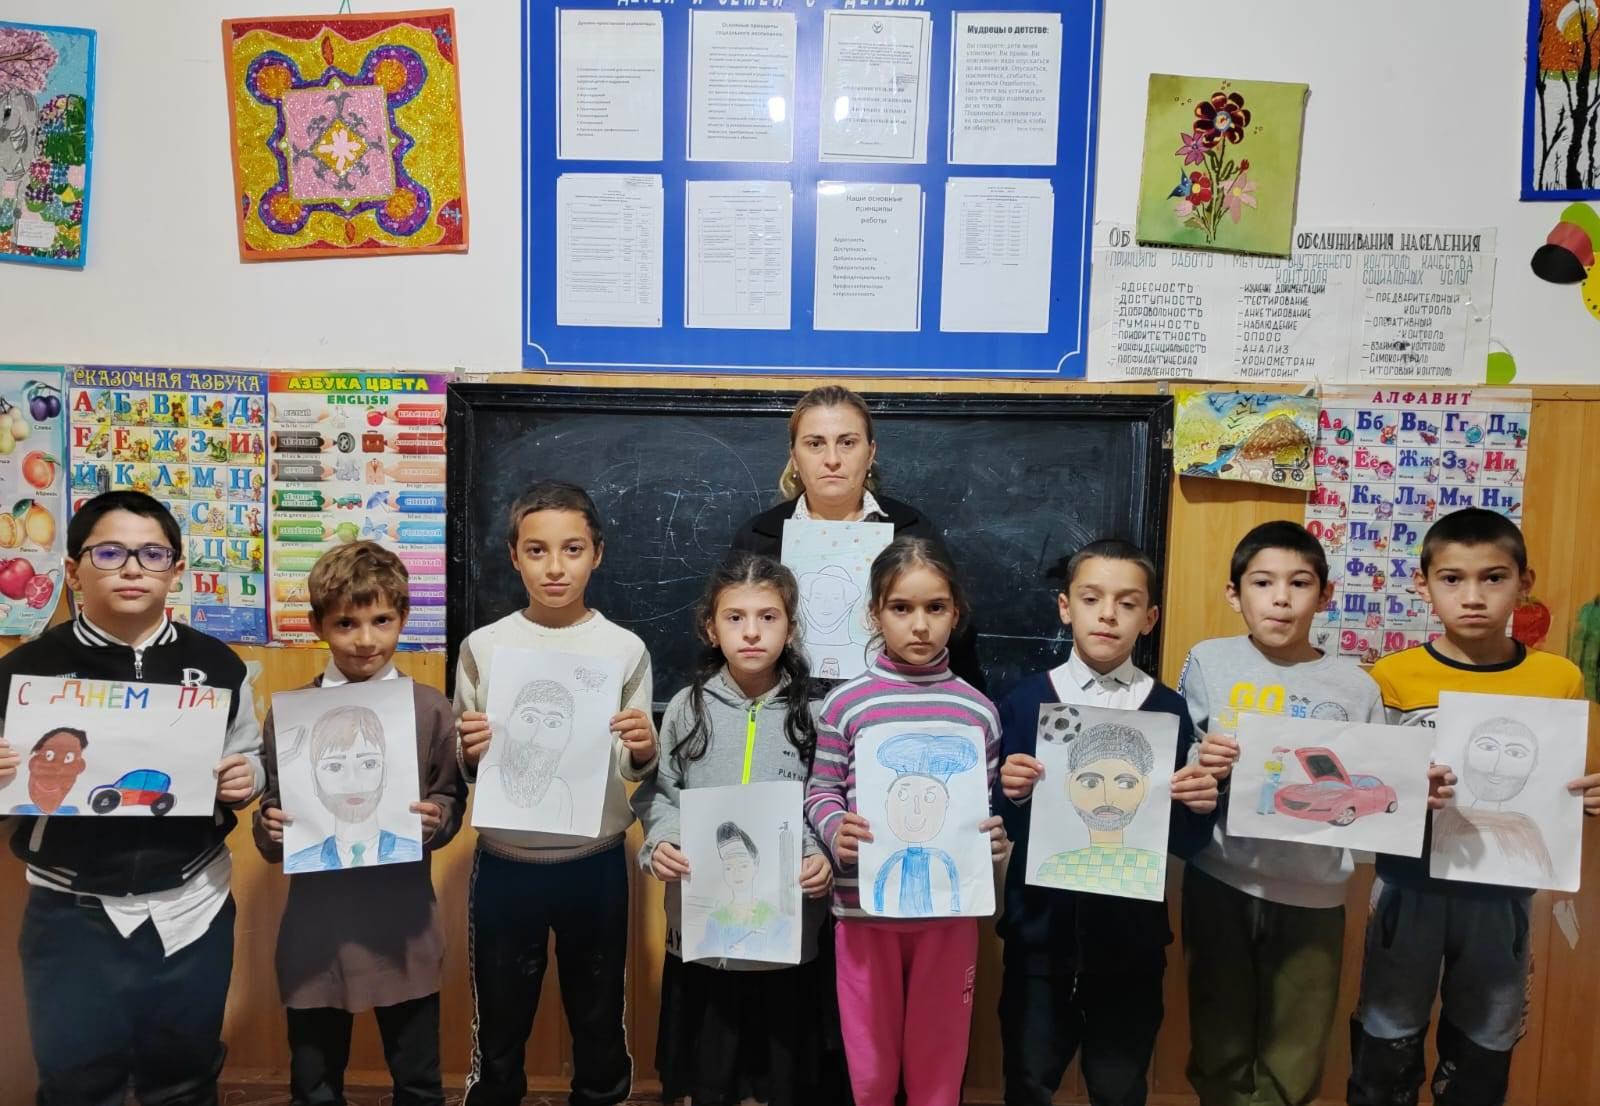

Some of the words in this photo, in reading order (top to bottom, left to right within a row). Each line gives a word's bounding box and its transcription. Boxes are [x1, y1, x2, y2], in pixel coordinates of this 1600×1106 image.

[967, 25, 1007, 34] Мудрецы
[860, 216, 887, 225] работы
[1109, 227, 1131, 248] ОБ
[1297, 232, 1394, 250] ОБСЛУЖИВАНИЯ
[1400, 233, 1482, 252] НАСЕЛЕНИЯ
[1421, 256, 1473, 270] КАЧЕСТВА
[1403, 304, 1452, 315] КОНТРОЛЬ
[1401, 329, 1444, 340] КОНТРОЛЬ
[73, 369, 182, 389] СКАЗОЧНАЯ
[189, 373, 261, 392] АЗБУКА
[288, 377, 362, 391] АЗБУКА
[365, 378, 430, 392] ЦВЕТА
[73, 391, 96, 413] А
[113, 392, 132, 414] Б
[152, 393, 170, 415] В
[190, 395, 207, 416] Г
[228, 396, 250, 424] Д
[327, 395, 389, 405] ENGLISH
[1372, 391, 1473, 406] АЛФАВИТ
[73, 426, 92, 448] Е
[114, 424, 132, 450] Ё
[152, 430, 179, 451] Ж
[191, 430, 207, 453] З
[229, 432, 252, 454] И
[74, 460, 97, 486] Й
[115, 463, 135, 485] К
[151, 464, 174, 488] Л
[192, 466, 217, 488] М
[229, 468, 252, 490] Н
[191, 502, 209, 524] С
[229, 503, 248, 525] Т
[202, 538, 226, 566] Ц
[230, 539, 250, 561] Ч
[193, 572, 218, 594] Ы
[240, 575, 257, 596] Ь
[18, 681, 32, 706] С
